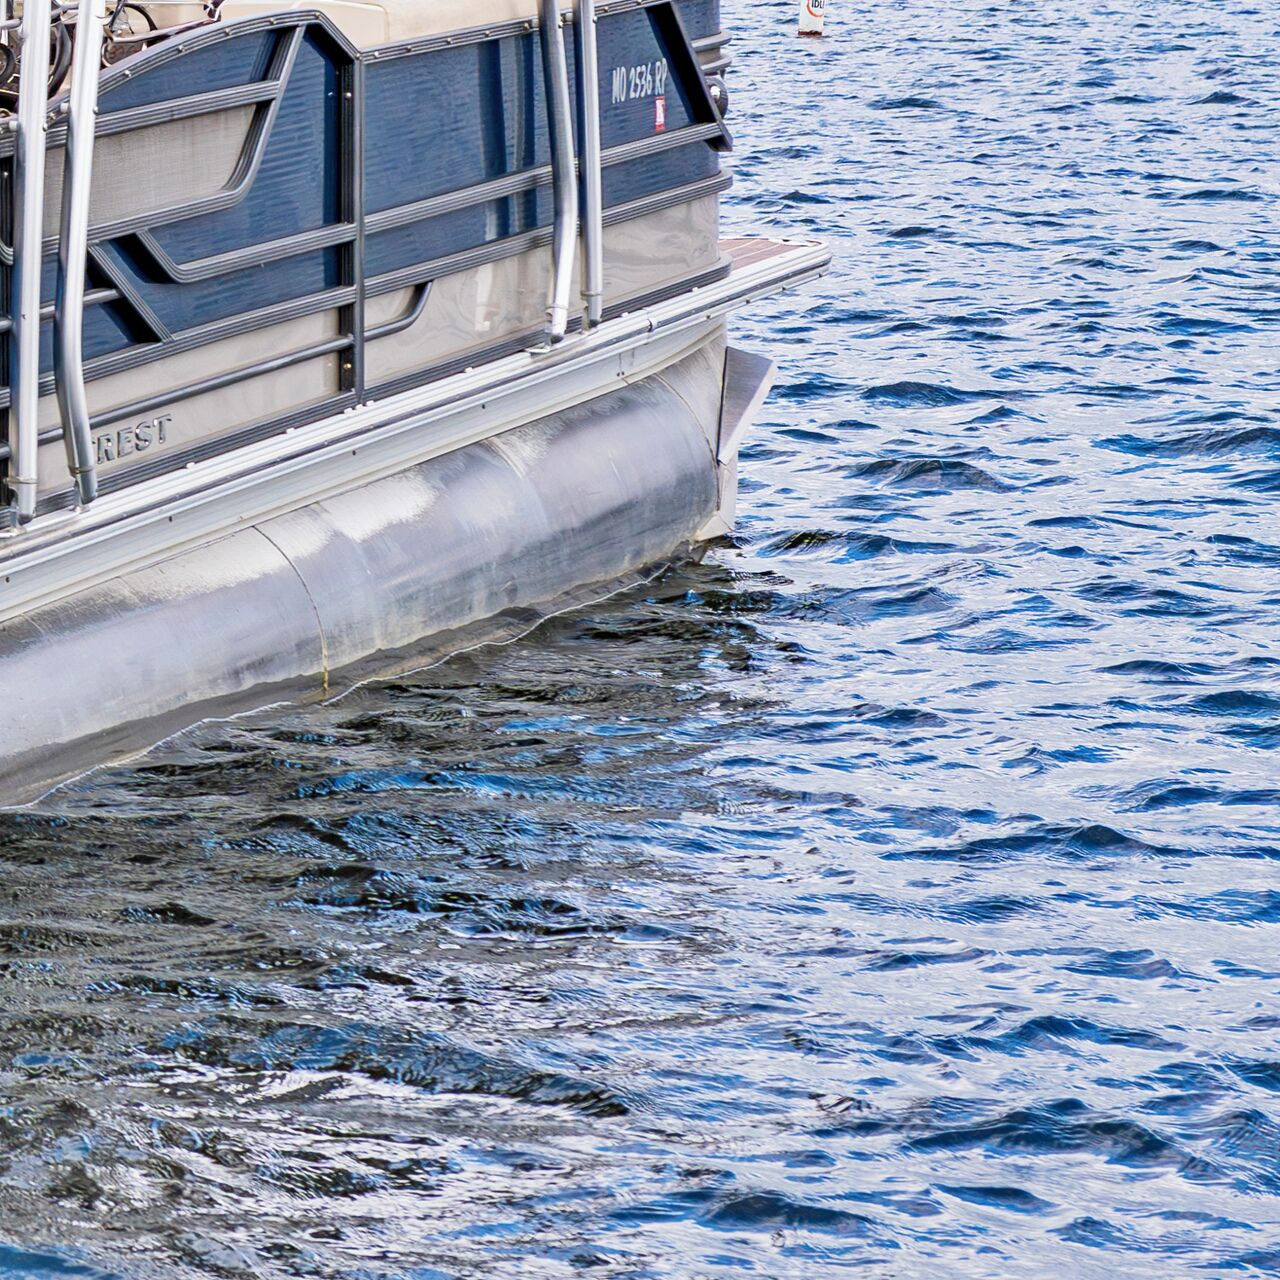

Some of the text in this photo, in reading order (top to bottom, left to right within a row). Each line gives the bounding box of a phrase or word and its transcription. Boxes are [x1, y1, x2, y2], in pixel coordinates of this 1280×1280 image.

[612, 57, 668, 104] MO 2536 RP
[91, 414, 172, 464] REST
